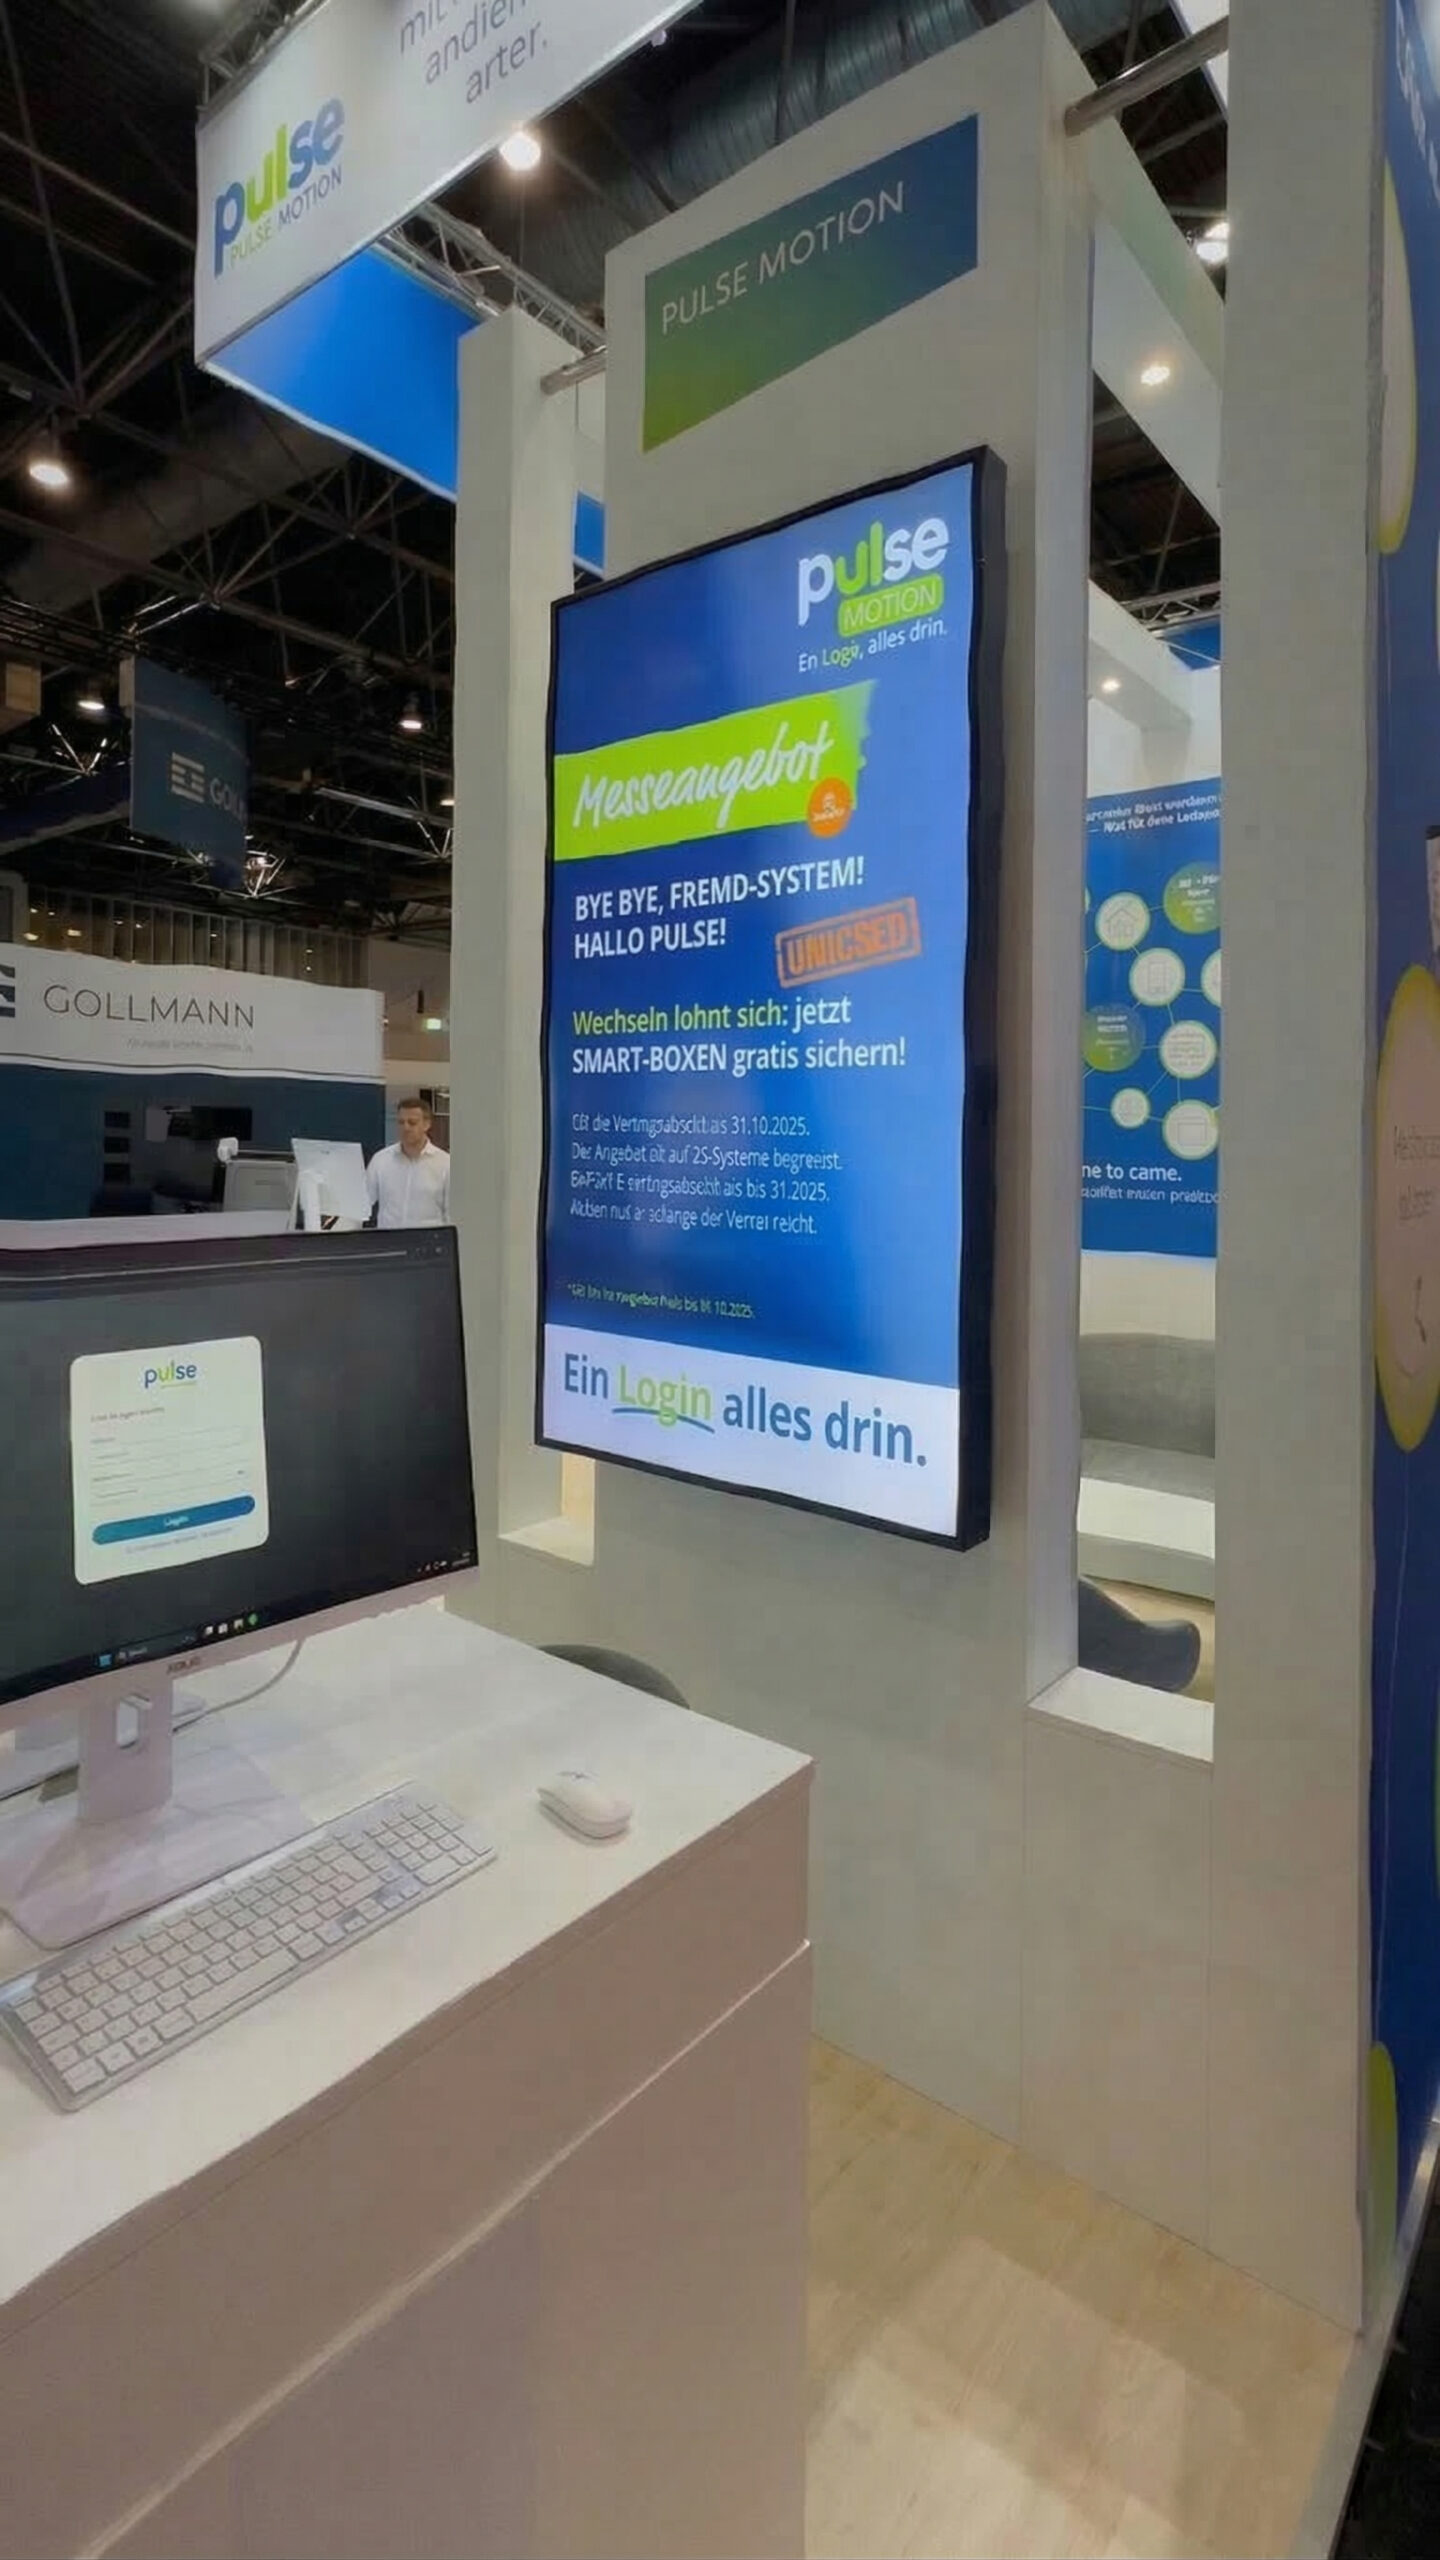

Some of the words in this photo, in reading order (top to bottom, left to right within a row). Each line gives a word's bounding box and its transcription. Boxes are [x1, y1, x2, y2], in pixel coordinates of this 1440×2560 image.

[214, 97, 345, 280] pulse
[279, 164, 342, 230] MOTION
[661, 261, 748, 335] PULSE
[758, 181, 905, 286] MOTION
[798, 517, 949, 627] pulse
[843, 581, 937, 632] MOTION
[867, 630, 906, 655] alles
[909, 617, 948, 642] drin.
[573, 721, 834, 829] Messeangebot
[575, 892, 612, 921] BYE
[619, 885, 664, 916] BYE,
[670, 856, 865, 910] FREMD-SYSTEM!
[574, 927, 644, 959] HALLO
[650, 917, 727, 953] PULSE!
[44, 984, 254, 1029] GOLLMANN
[573, 1007, 667, 1036] Wechseln
[674, 1003, 731, 1031] lohnt
[737, 998, 789, 1028] sich:
[792, 995, 852, 1033] jetzt
[572, 1043, 727, 1074] SMART-BOXEN
[732, 1040, 799, 1077] gratis
[804, 1036, 907, 1069] sichern!
[731, 1115, 810, 1137] 31.10.2025.
[1106, 1163, 1124, 1180] to
[1129, 1166, 1182, 1182] came.
[144, 1360, 197, 1389] pulse
[564, 1352, 608, 1400] Ein
[617, 1365, 711, 1427] Login
[723, 1385, 812, 1442] alles
[825, 1400, 928, 1468] drin.
